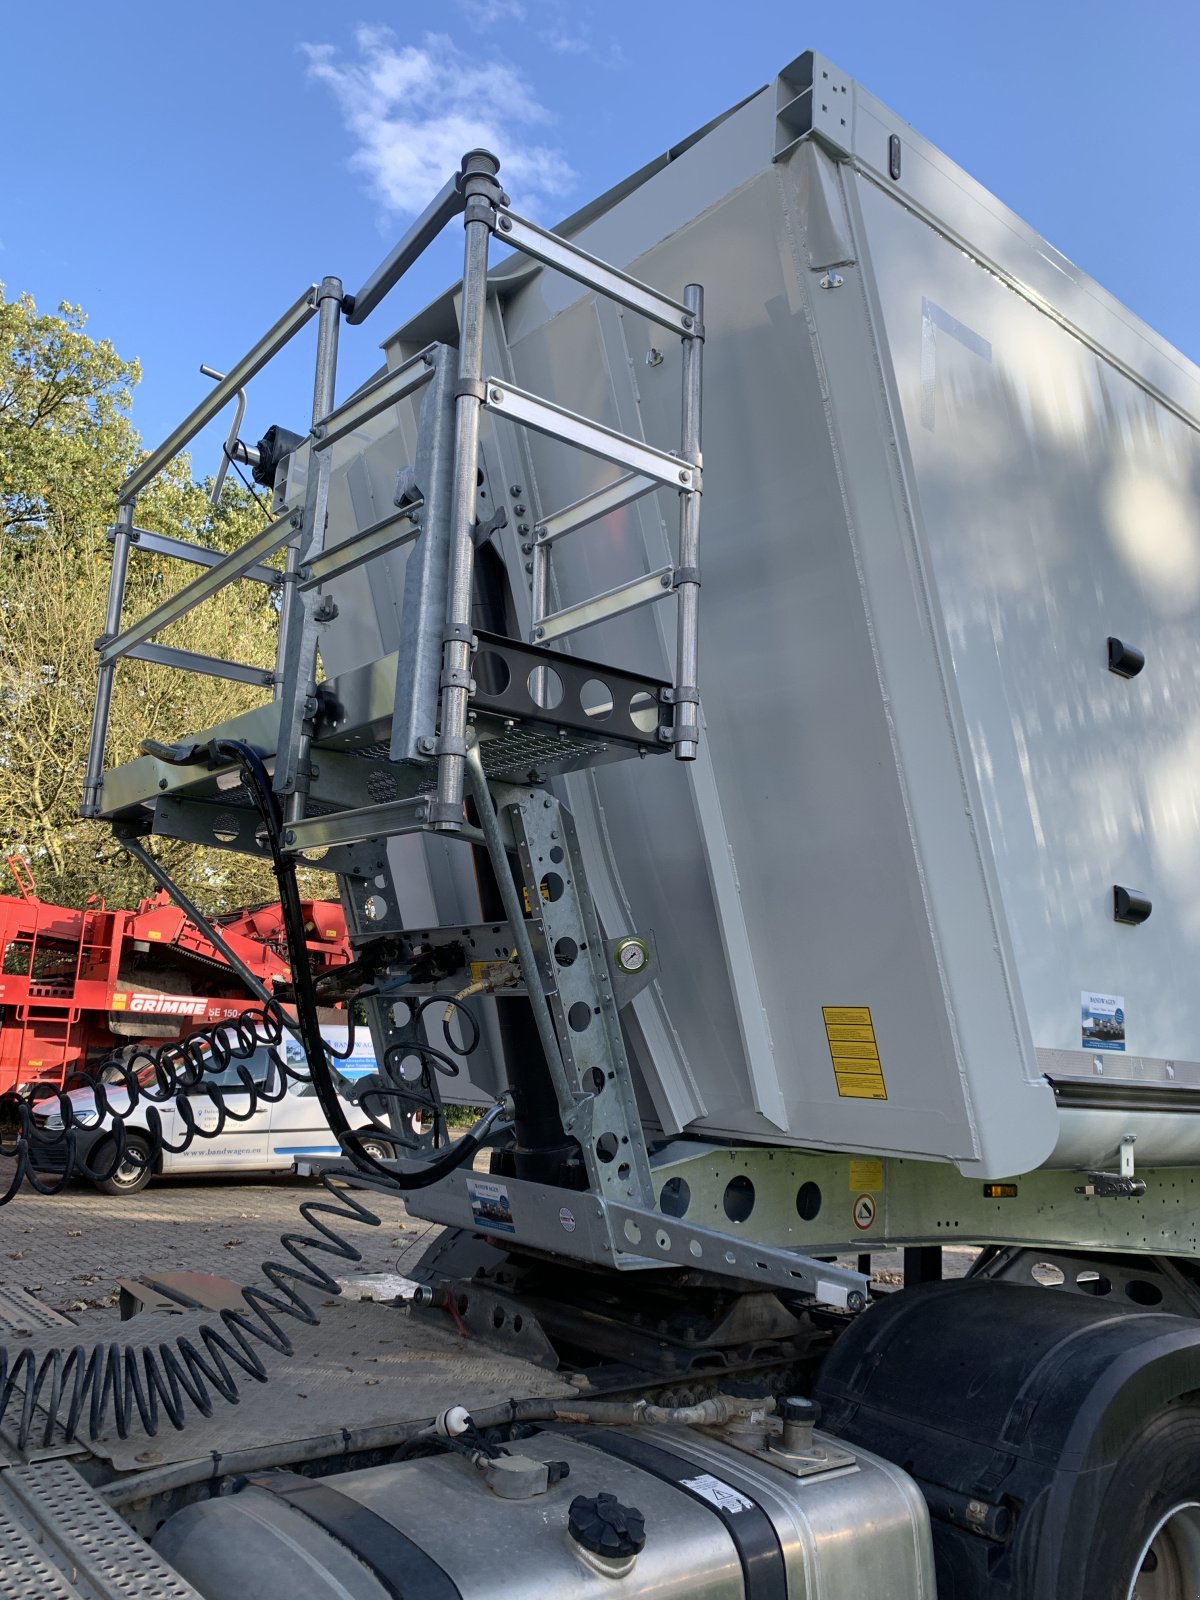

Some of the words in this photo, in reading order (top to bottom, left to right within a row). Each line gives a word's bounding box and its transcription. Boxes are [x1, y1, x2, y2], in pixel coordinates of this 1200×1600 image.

[130, 994, 208, 1015] GRIMME
[208, 1007, 221, 1017] SE
[183, 1147, 261, 1157] www.bandwagen.eu
